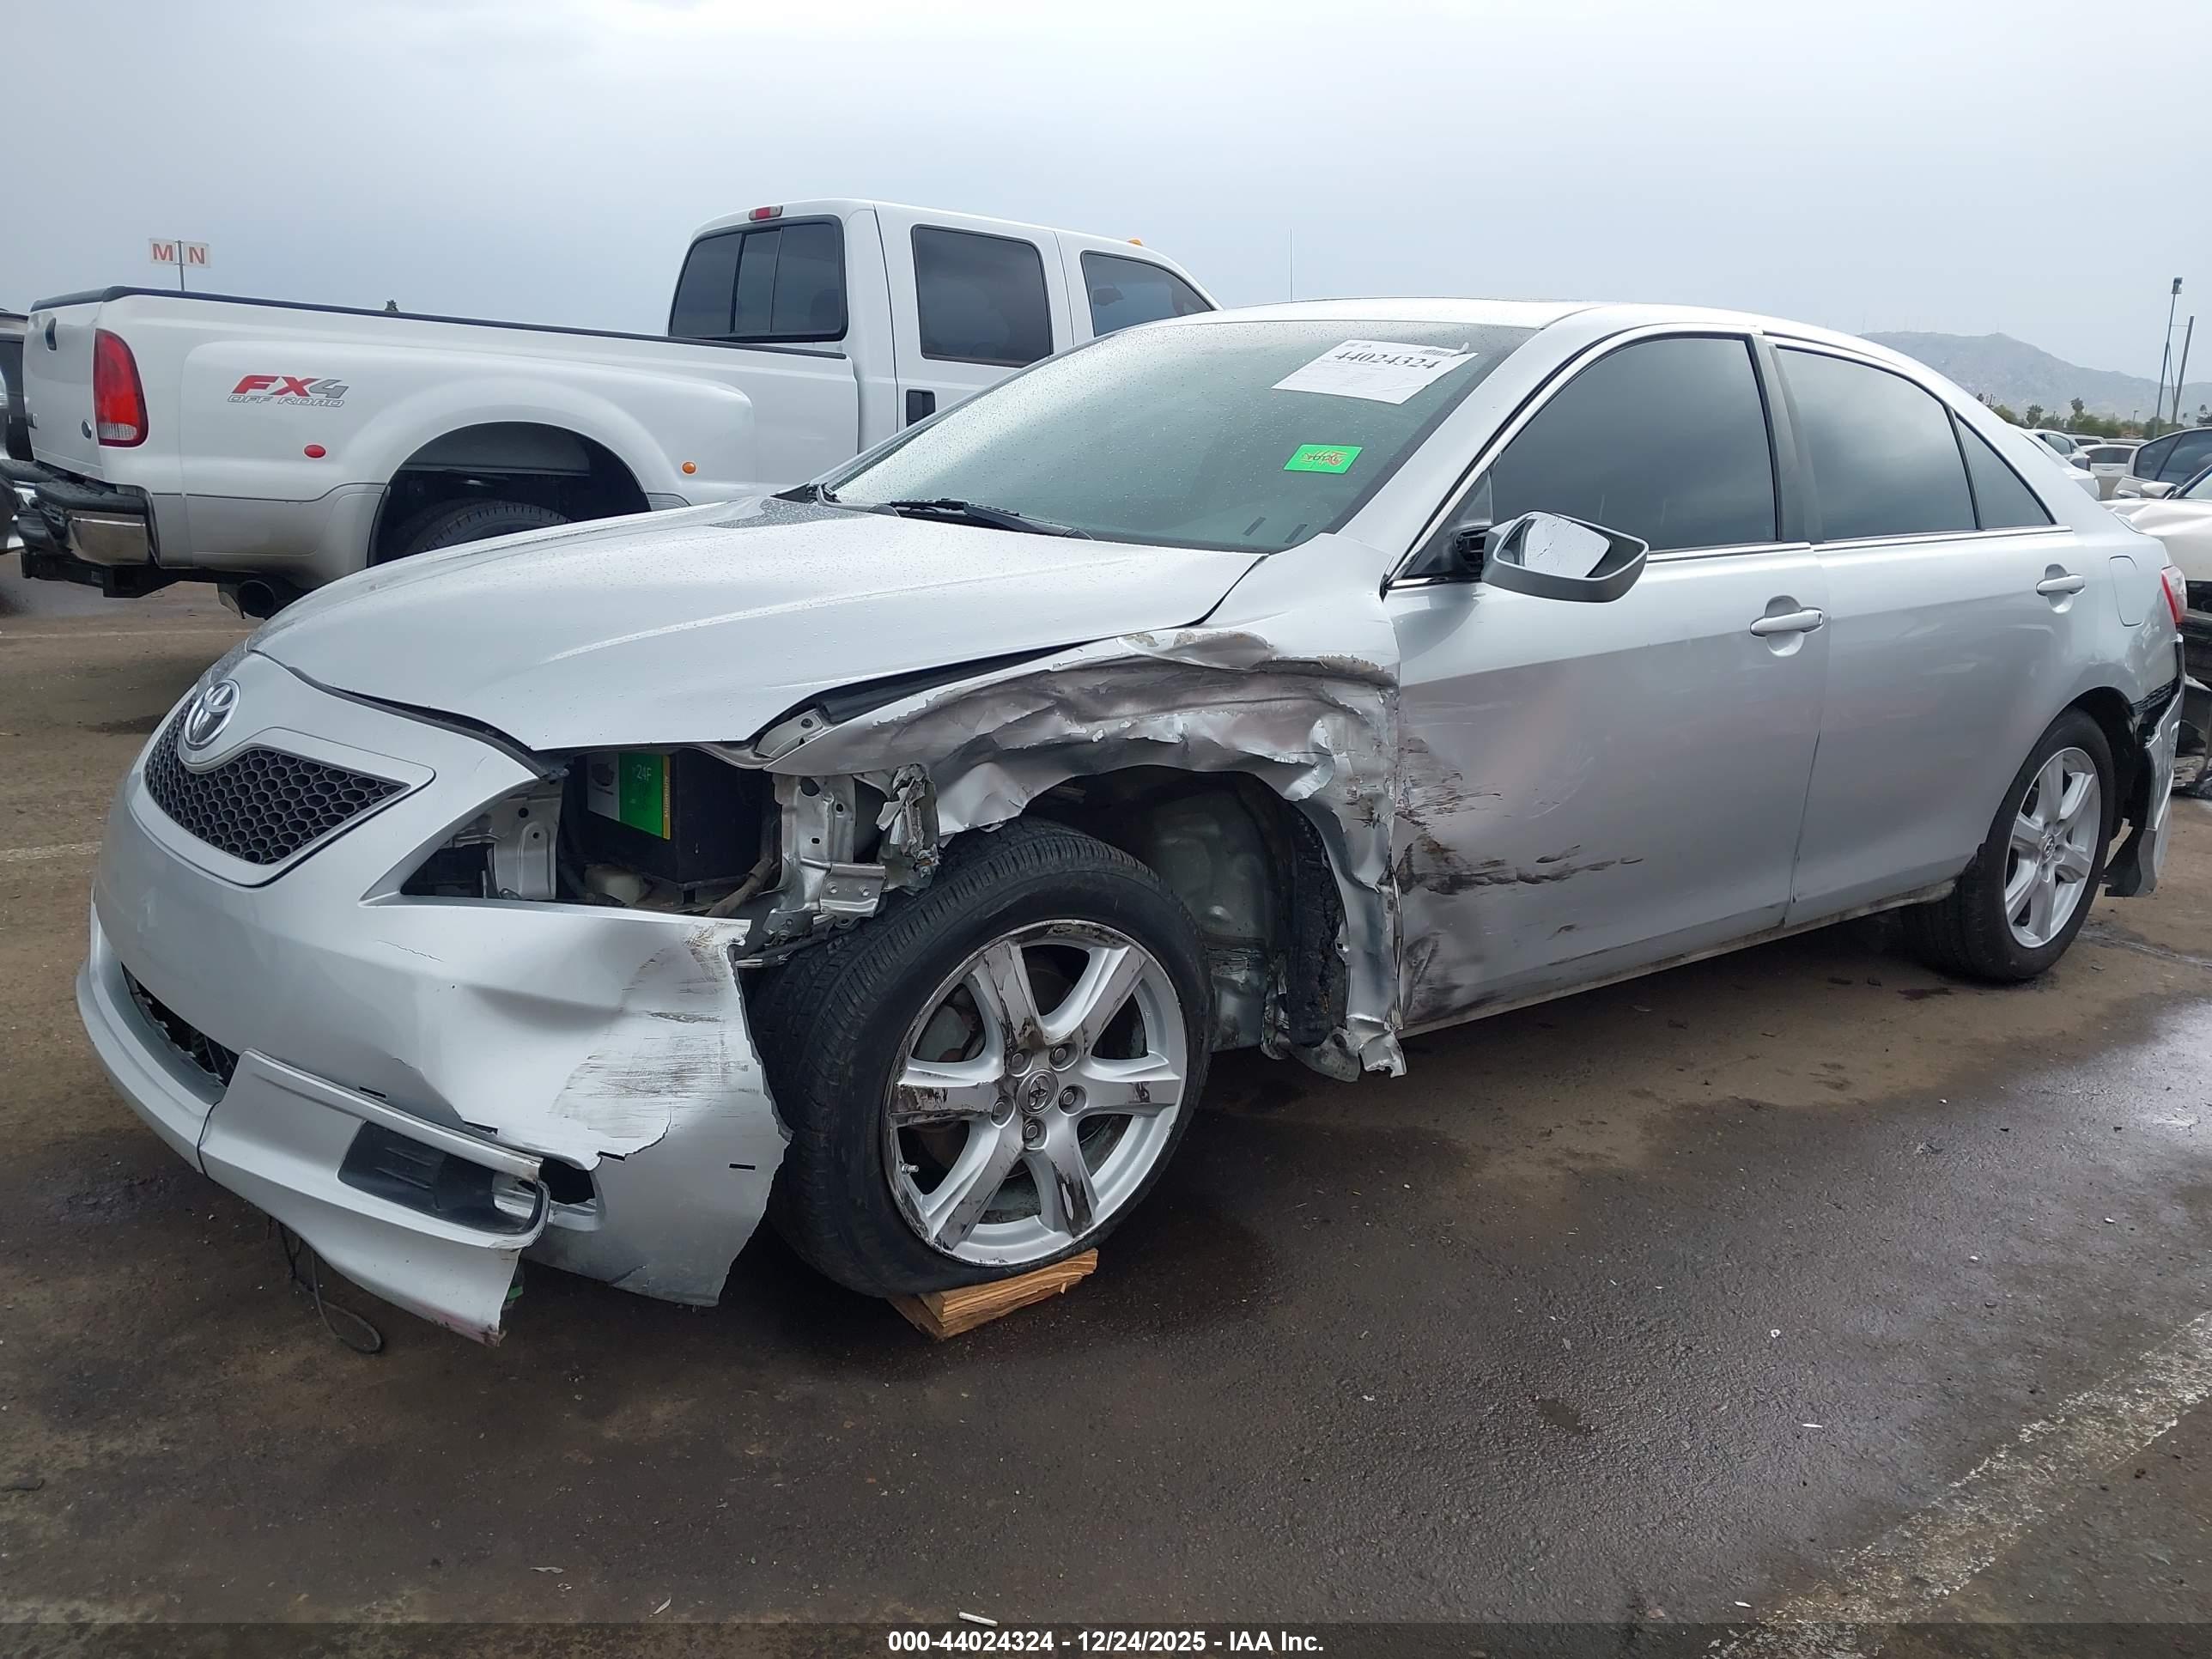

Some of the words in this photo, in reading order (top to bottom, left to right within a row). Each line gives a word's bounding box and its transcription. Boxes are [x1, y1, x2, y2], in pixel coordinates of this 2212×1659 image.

[152, 243, 173, 262] M
[189, 246, 205, 264] N
[1334, 350, 1443, 369] 44024324
[231, 374, 349, 398] FX4
[227, 394, 274, 404] OFF
[277, 397, 345, 408] ROAD
